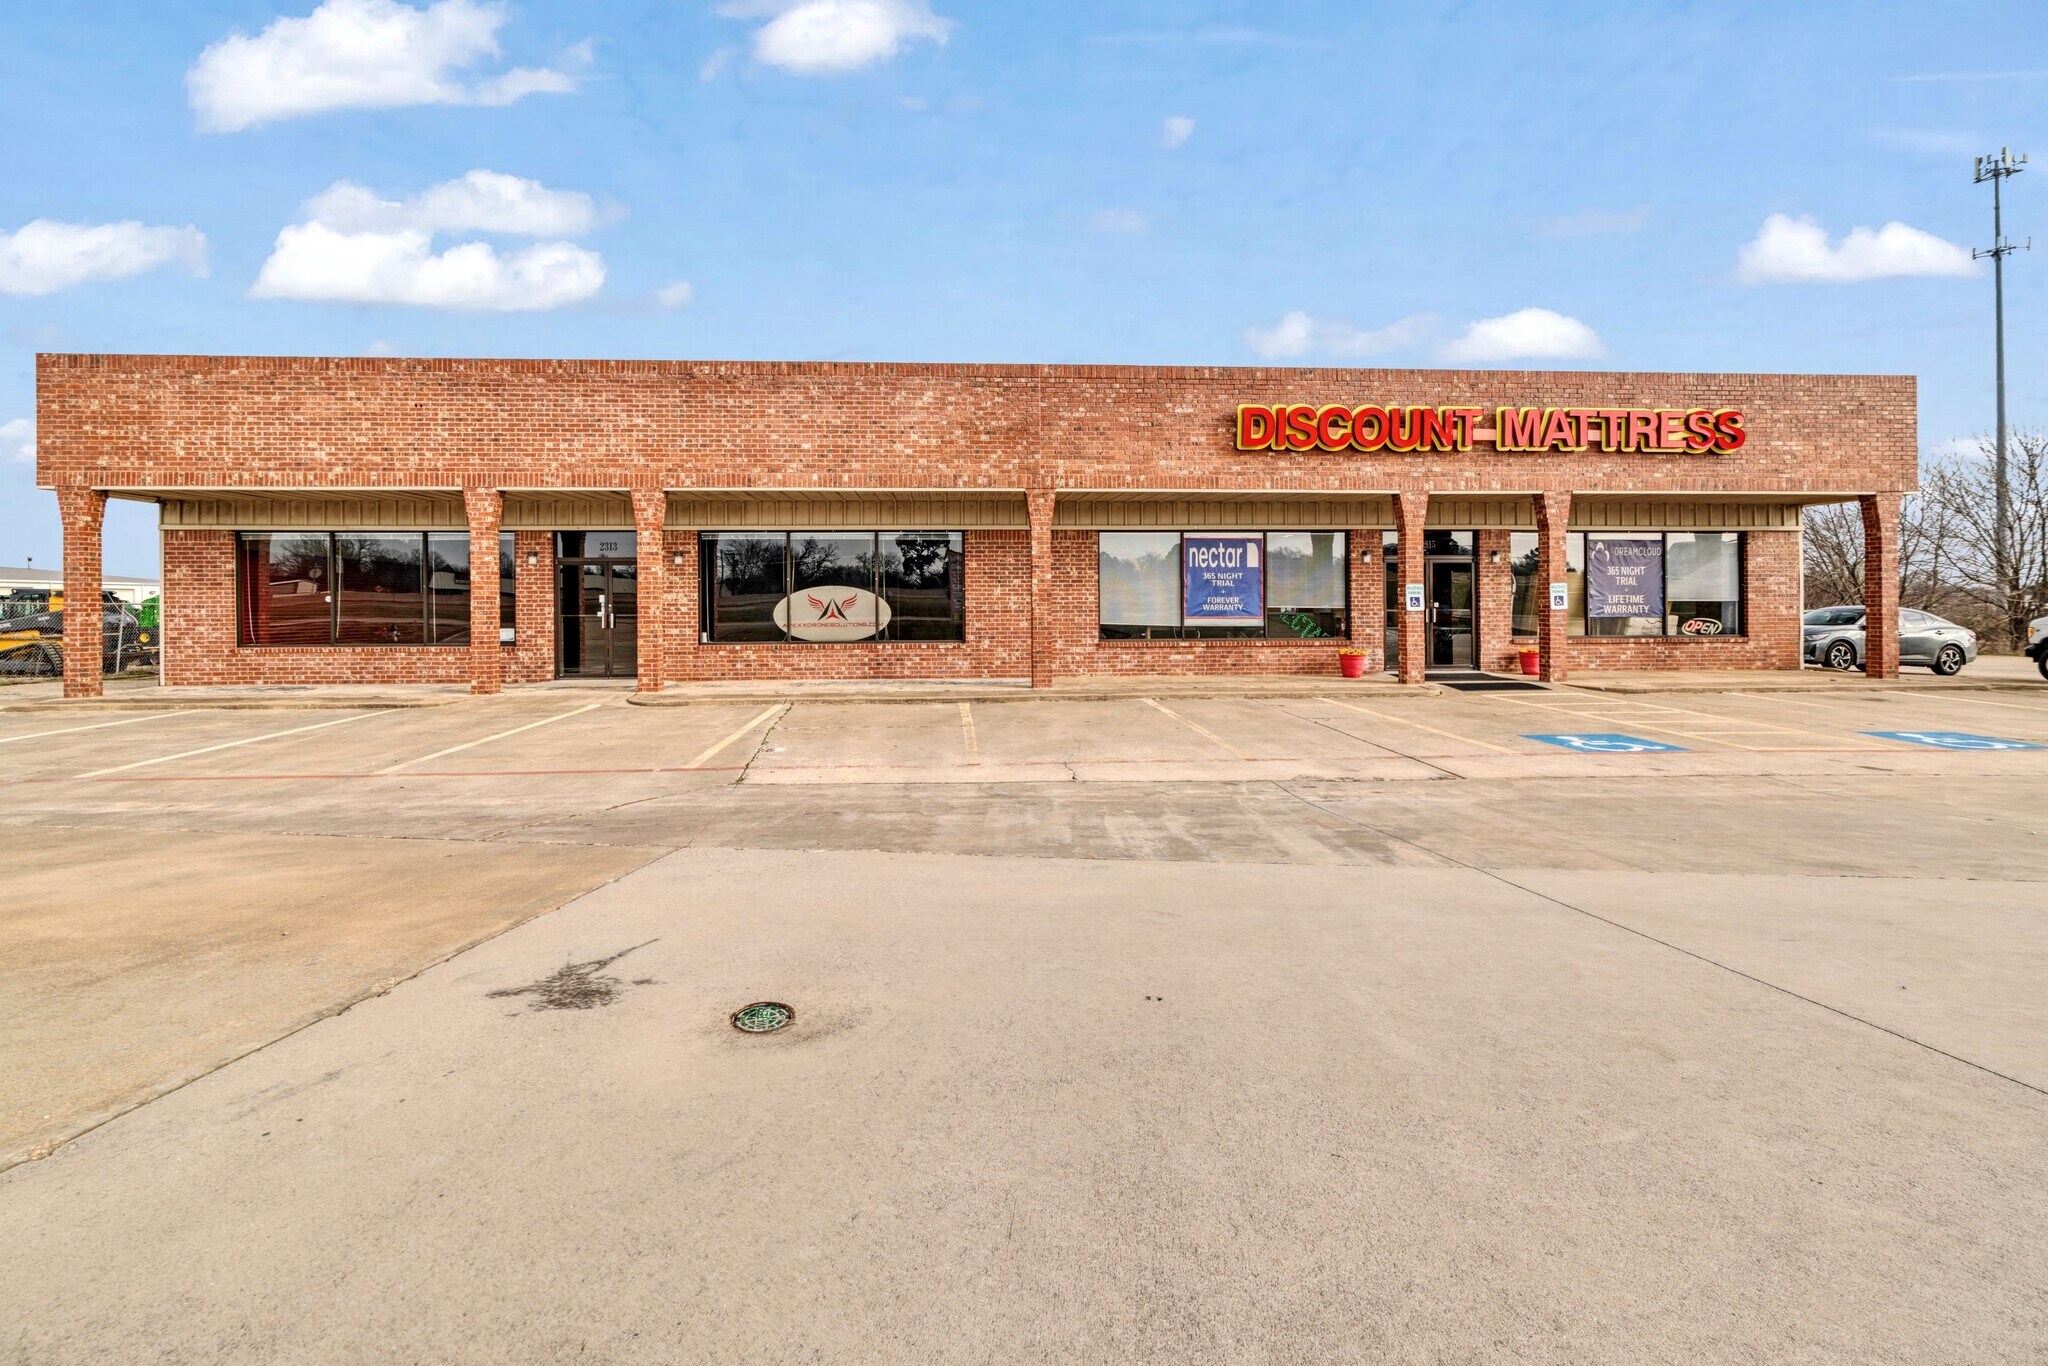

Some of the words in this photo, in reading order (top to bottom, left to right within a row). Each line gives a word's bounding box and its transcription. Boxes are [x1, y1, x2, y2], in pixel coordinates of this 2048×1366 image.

[1237, 404, 1484, 451] DISCOUNT
[1497, 406, 1746, 454] MATTRESS
[599, 541, 618, 551] 2313
[1189, 542, 1243, 568] nectar
[1614, 547, 1662, 556] DREAMCLOUD
[1202, 572, 1216, 580] 365
[1217, 572, 1243, 580] NIGHT
[1607, 566, 1619, 576] 365
[1621, 566, 1645, 576] NIGHT
[1211, 579, 1235, 587] TRIAL
[1615, 576, 1637, 585] TRIAL
[1207, 596, 1240, 604] FOREVER
[1608, 594, 1645, 604] LIFETIME
[1603, 604, 1649, 614] WARRANTY
[1684, 619, 1718, 635] OPEN
